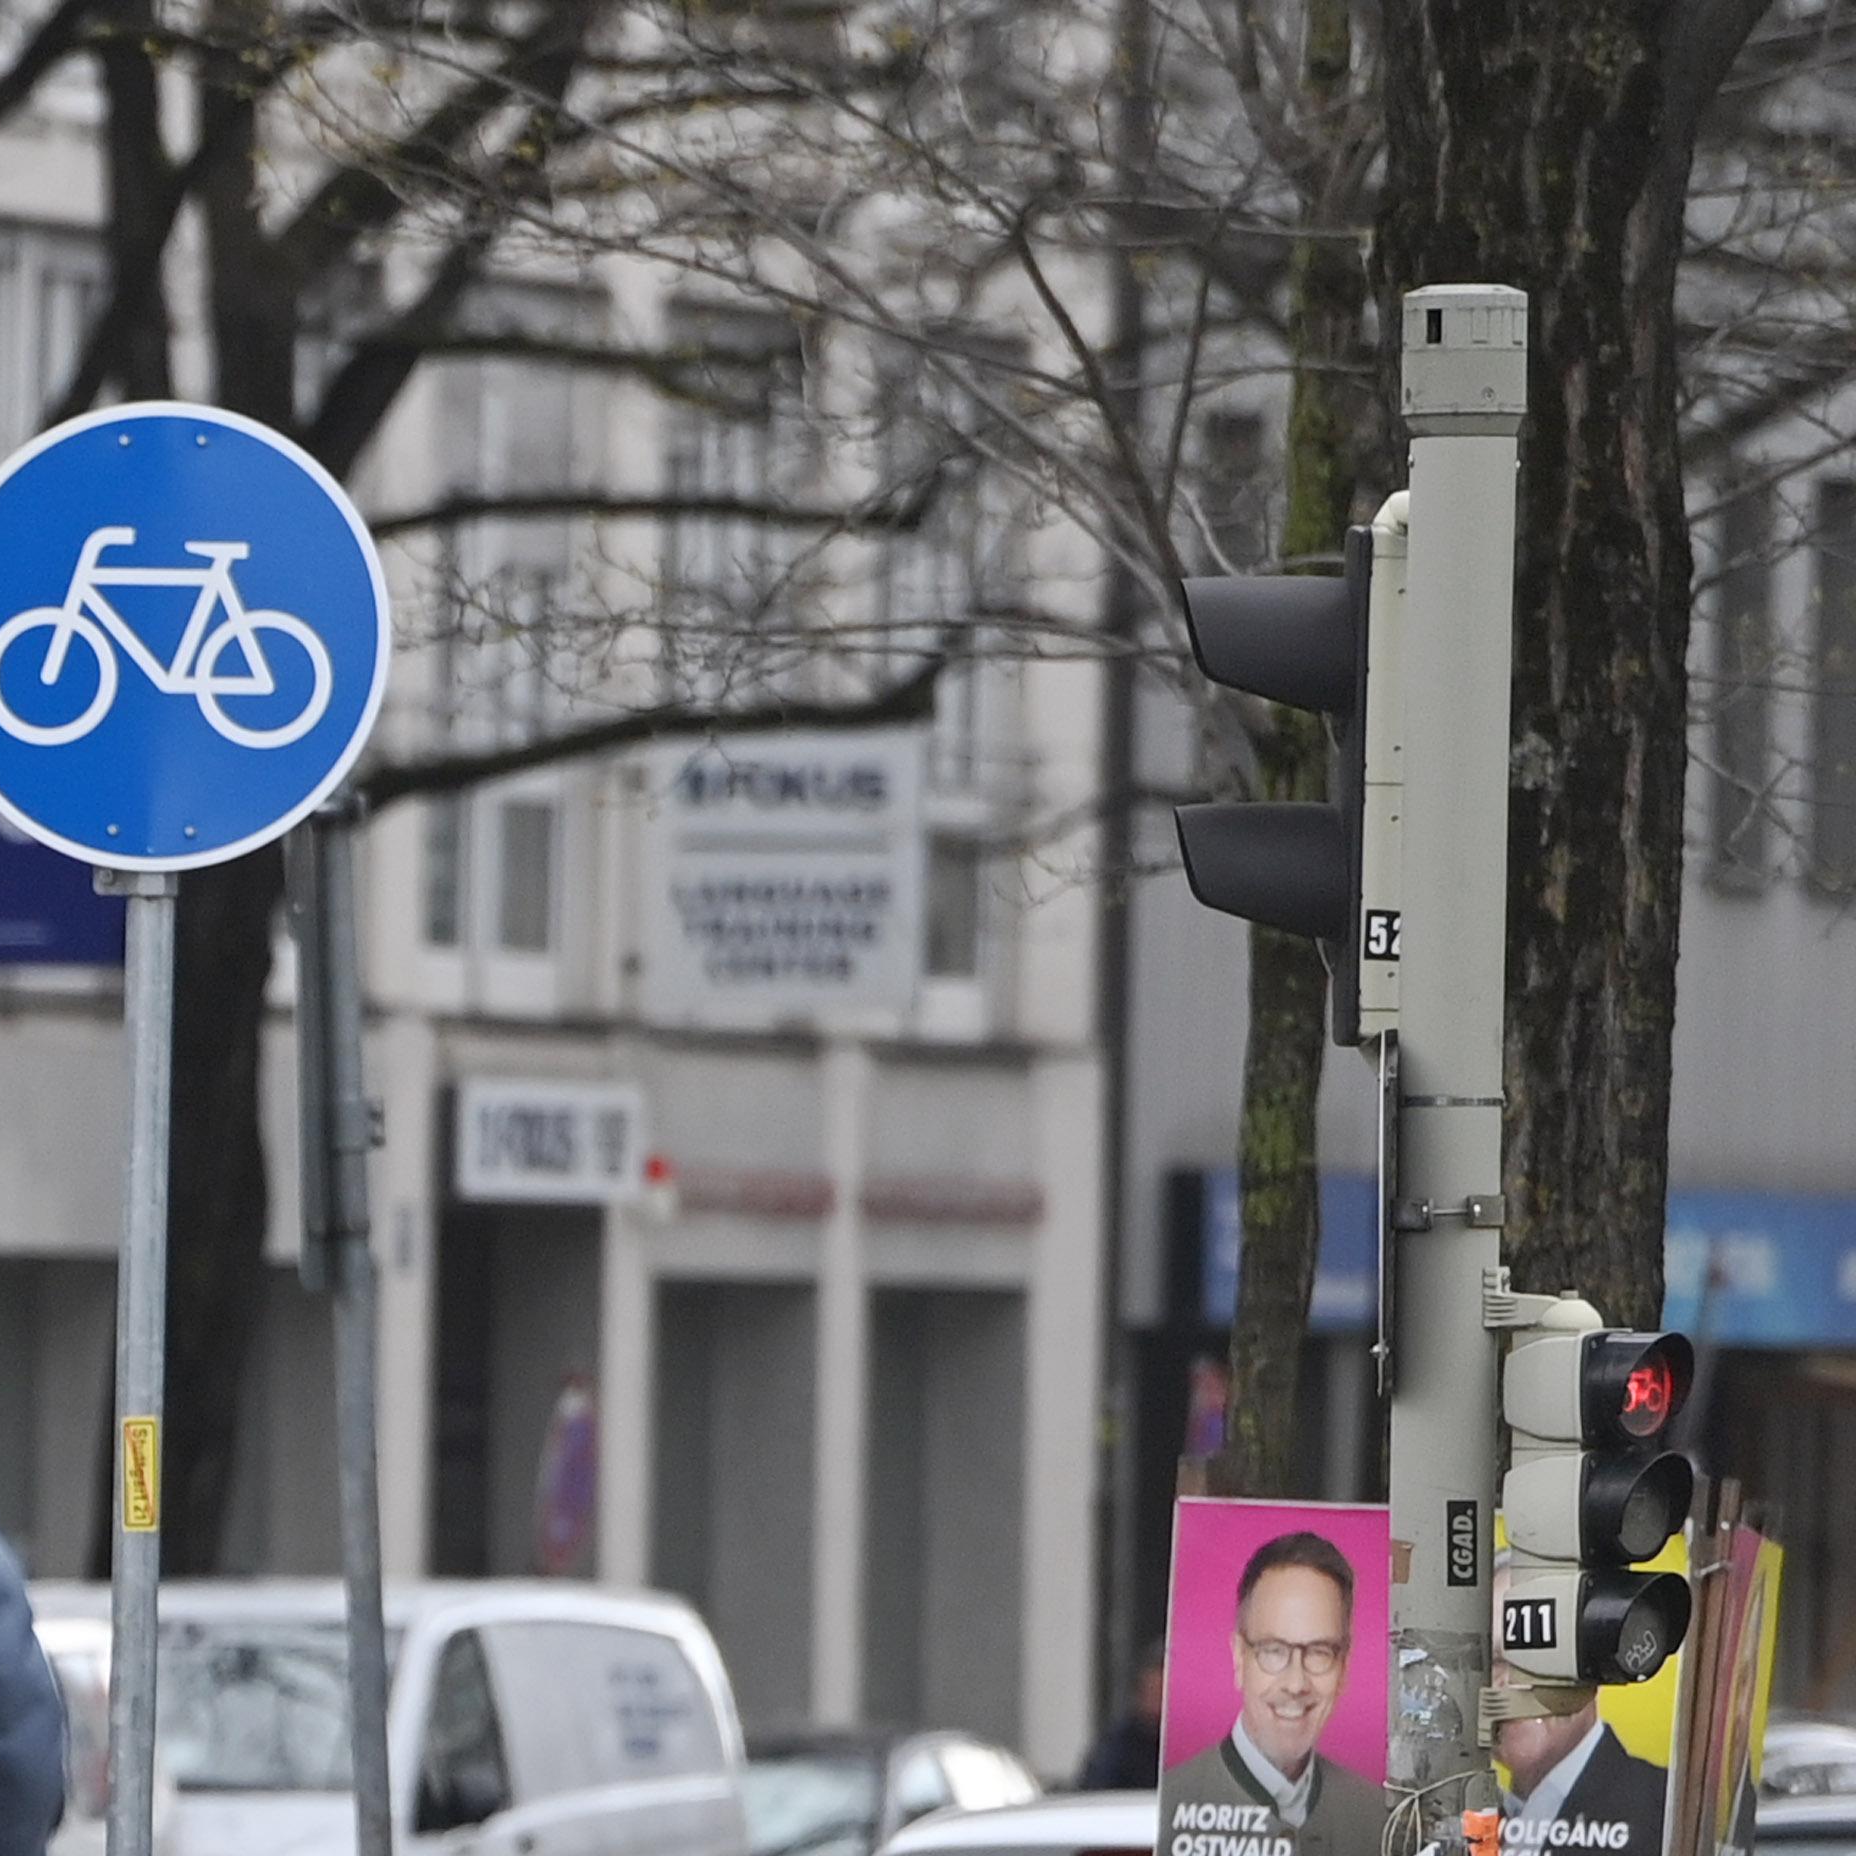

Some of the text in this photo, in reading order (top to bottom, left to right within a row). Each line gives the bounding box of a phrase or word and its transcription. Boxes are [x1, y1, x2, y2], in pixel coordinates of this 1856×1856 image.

[1452, 1507, 1475, 1579] CGAD.
[1505, 1604, 1552, 1644] 211
[1172, 1802, 1271, 1833] MORITZ
